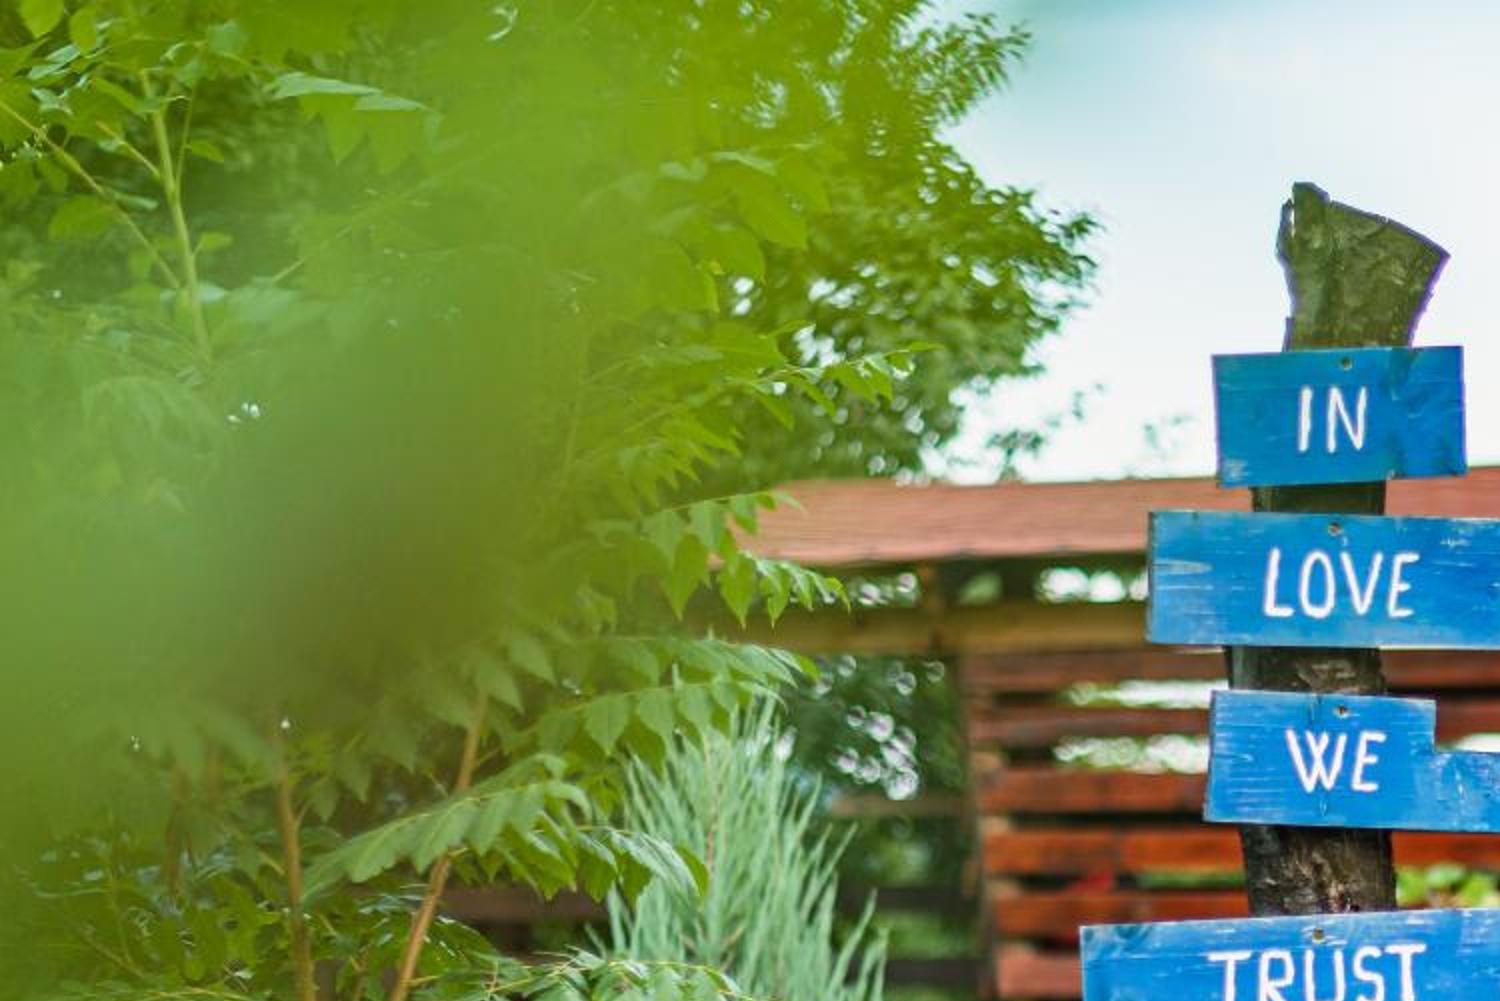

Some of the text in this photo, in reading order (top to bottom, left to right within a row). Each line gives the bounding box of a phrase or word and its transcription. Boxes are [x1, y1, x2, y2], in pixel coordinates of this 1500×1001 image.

[1298, 386, 1368, 454] IN
[1262, 547, 1420, 620] LOVE
[1284, 727, 1387, 794] WE
